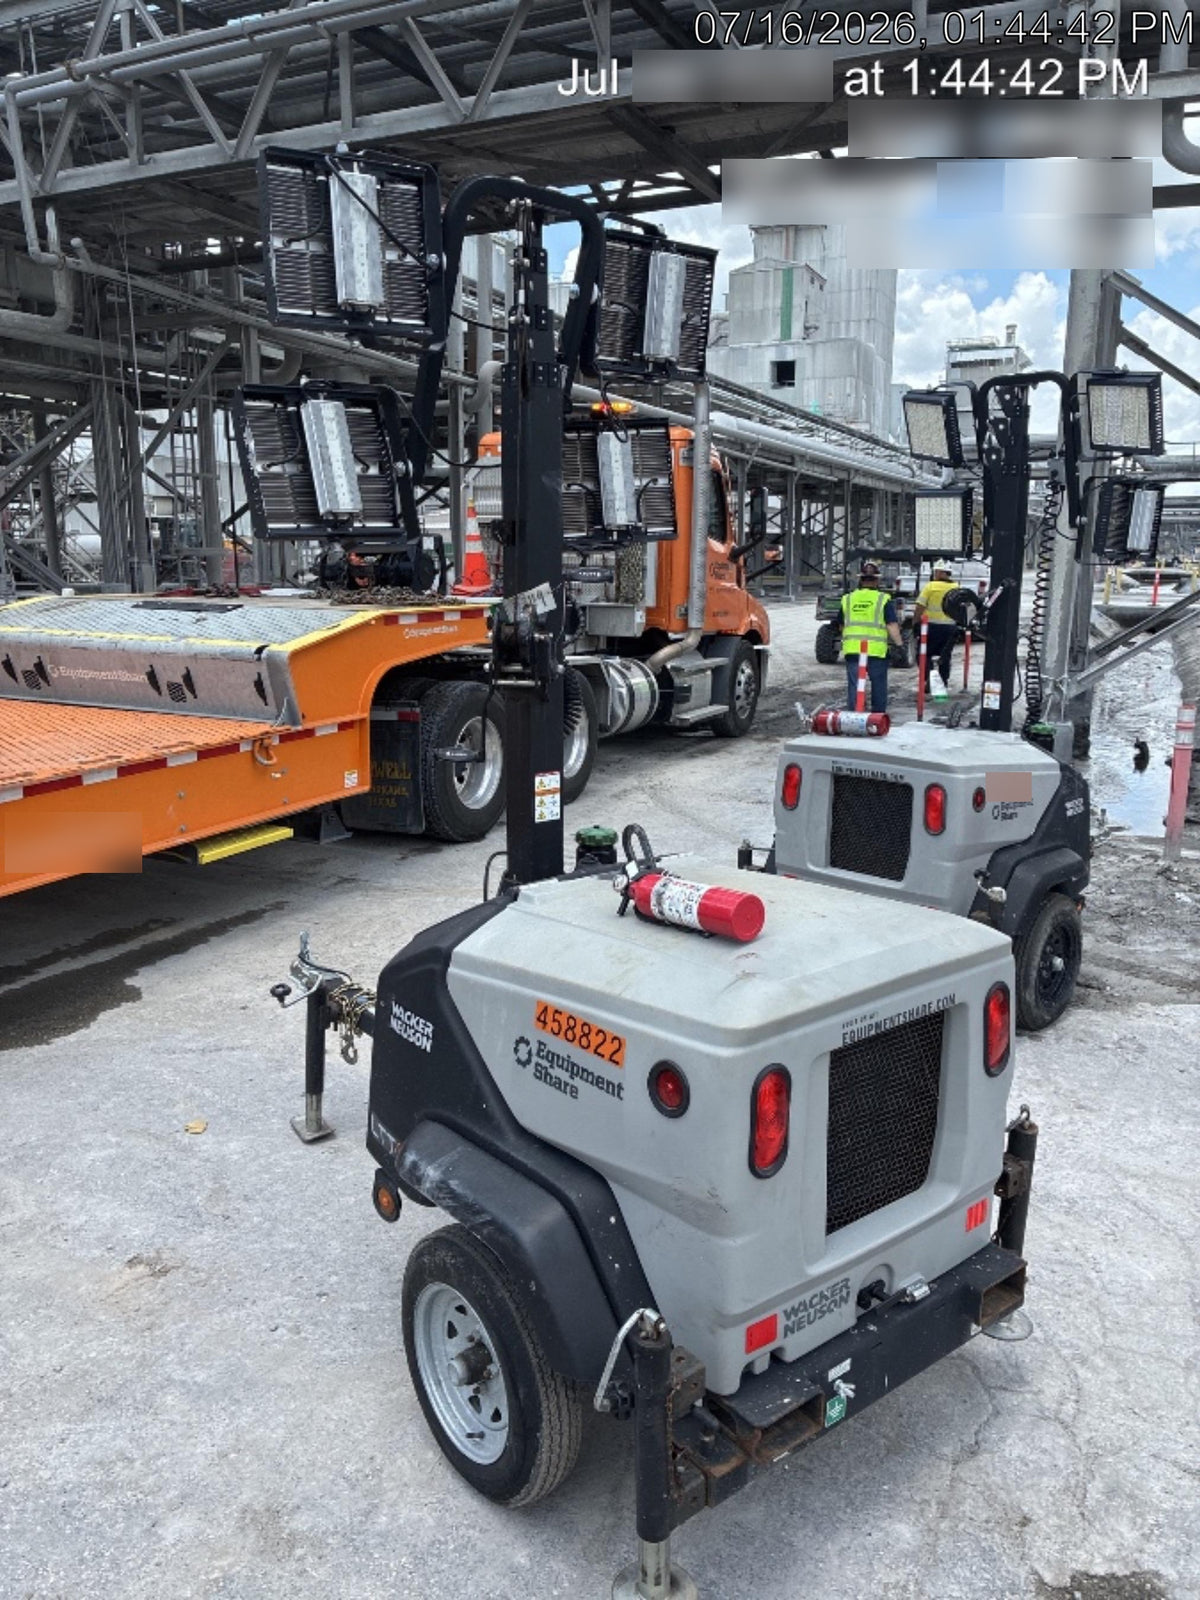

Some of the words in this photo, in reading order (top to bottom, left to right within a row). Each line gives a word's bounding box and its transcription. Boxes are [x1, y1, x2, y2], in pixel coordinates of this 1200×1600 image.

[390, 1015, 433, 1053] NEUSON
[392, 1000, 433, 1038] WACKER
[536, 1005, 623, 1066] 458822
[533, 1061, 579, 1100] Share
[535, 1039, 624, 1101] Equipment
[783, 1278, 851, 1322] WACKER
[783, 1290, 850, 1339] NEUSON
